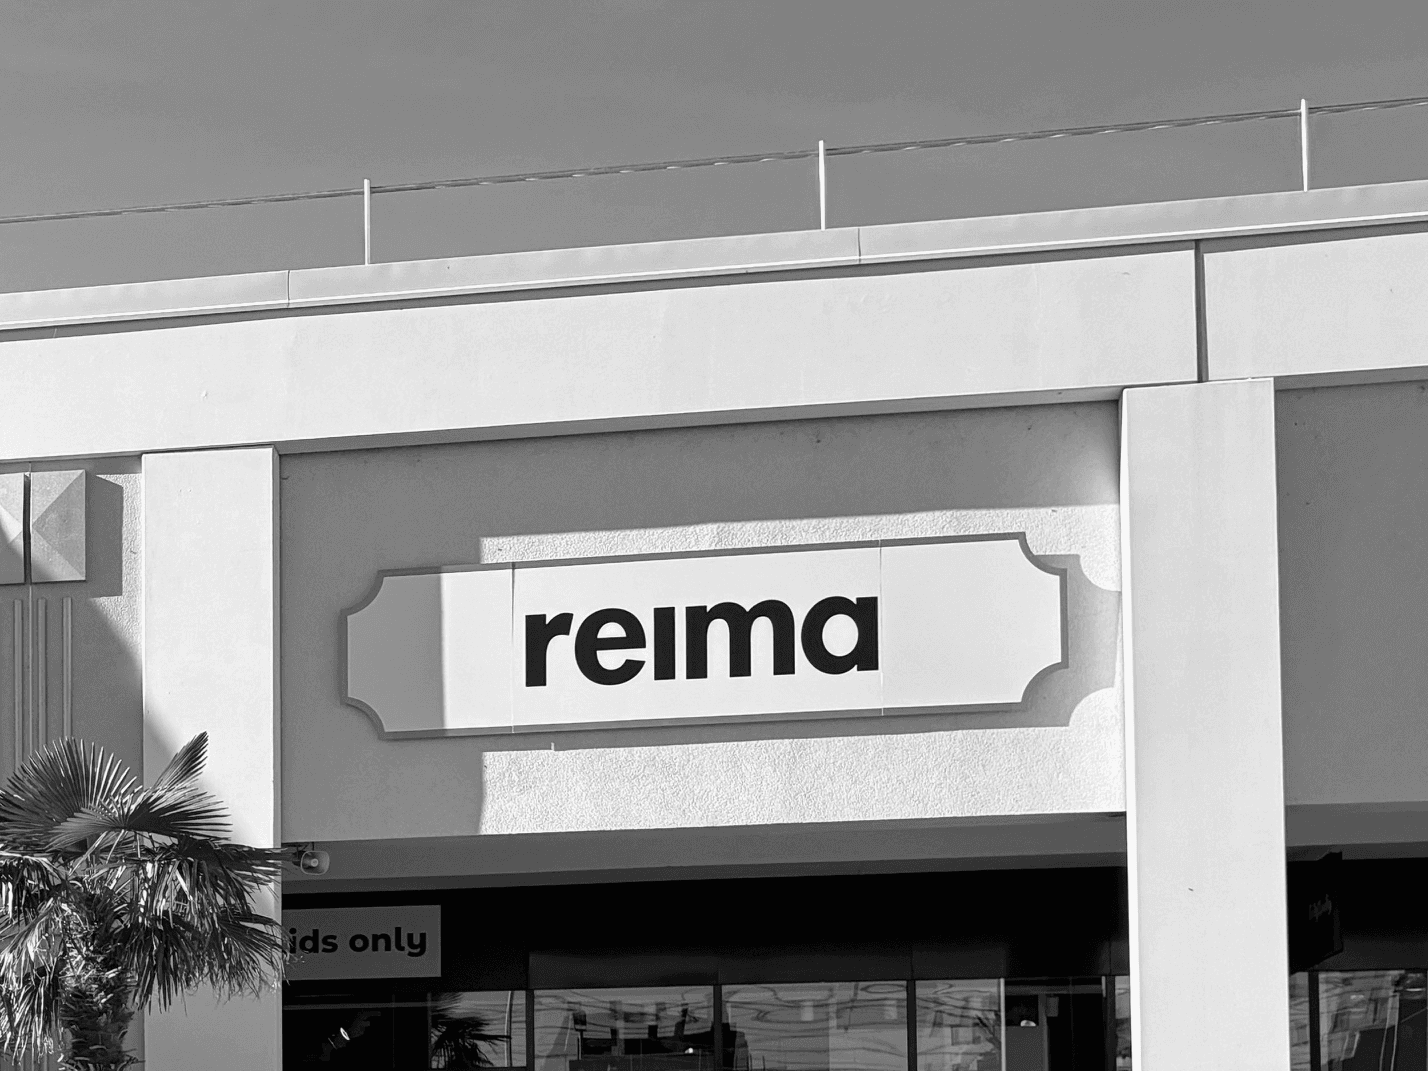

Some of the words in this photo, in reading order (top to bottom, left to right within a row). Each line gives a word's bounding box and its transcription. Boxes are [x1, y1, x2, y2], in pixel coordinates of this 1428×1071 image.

[525, 595, 879, 688] reima
[288, 927, 339, 954] ids
[348, 926, 427, 958] only
